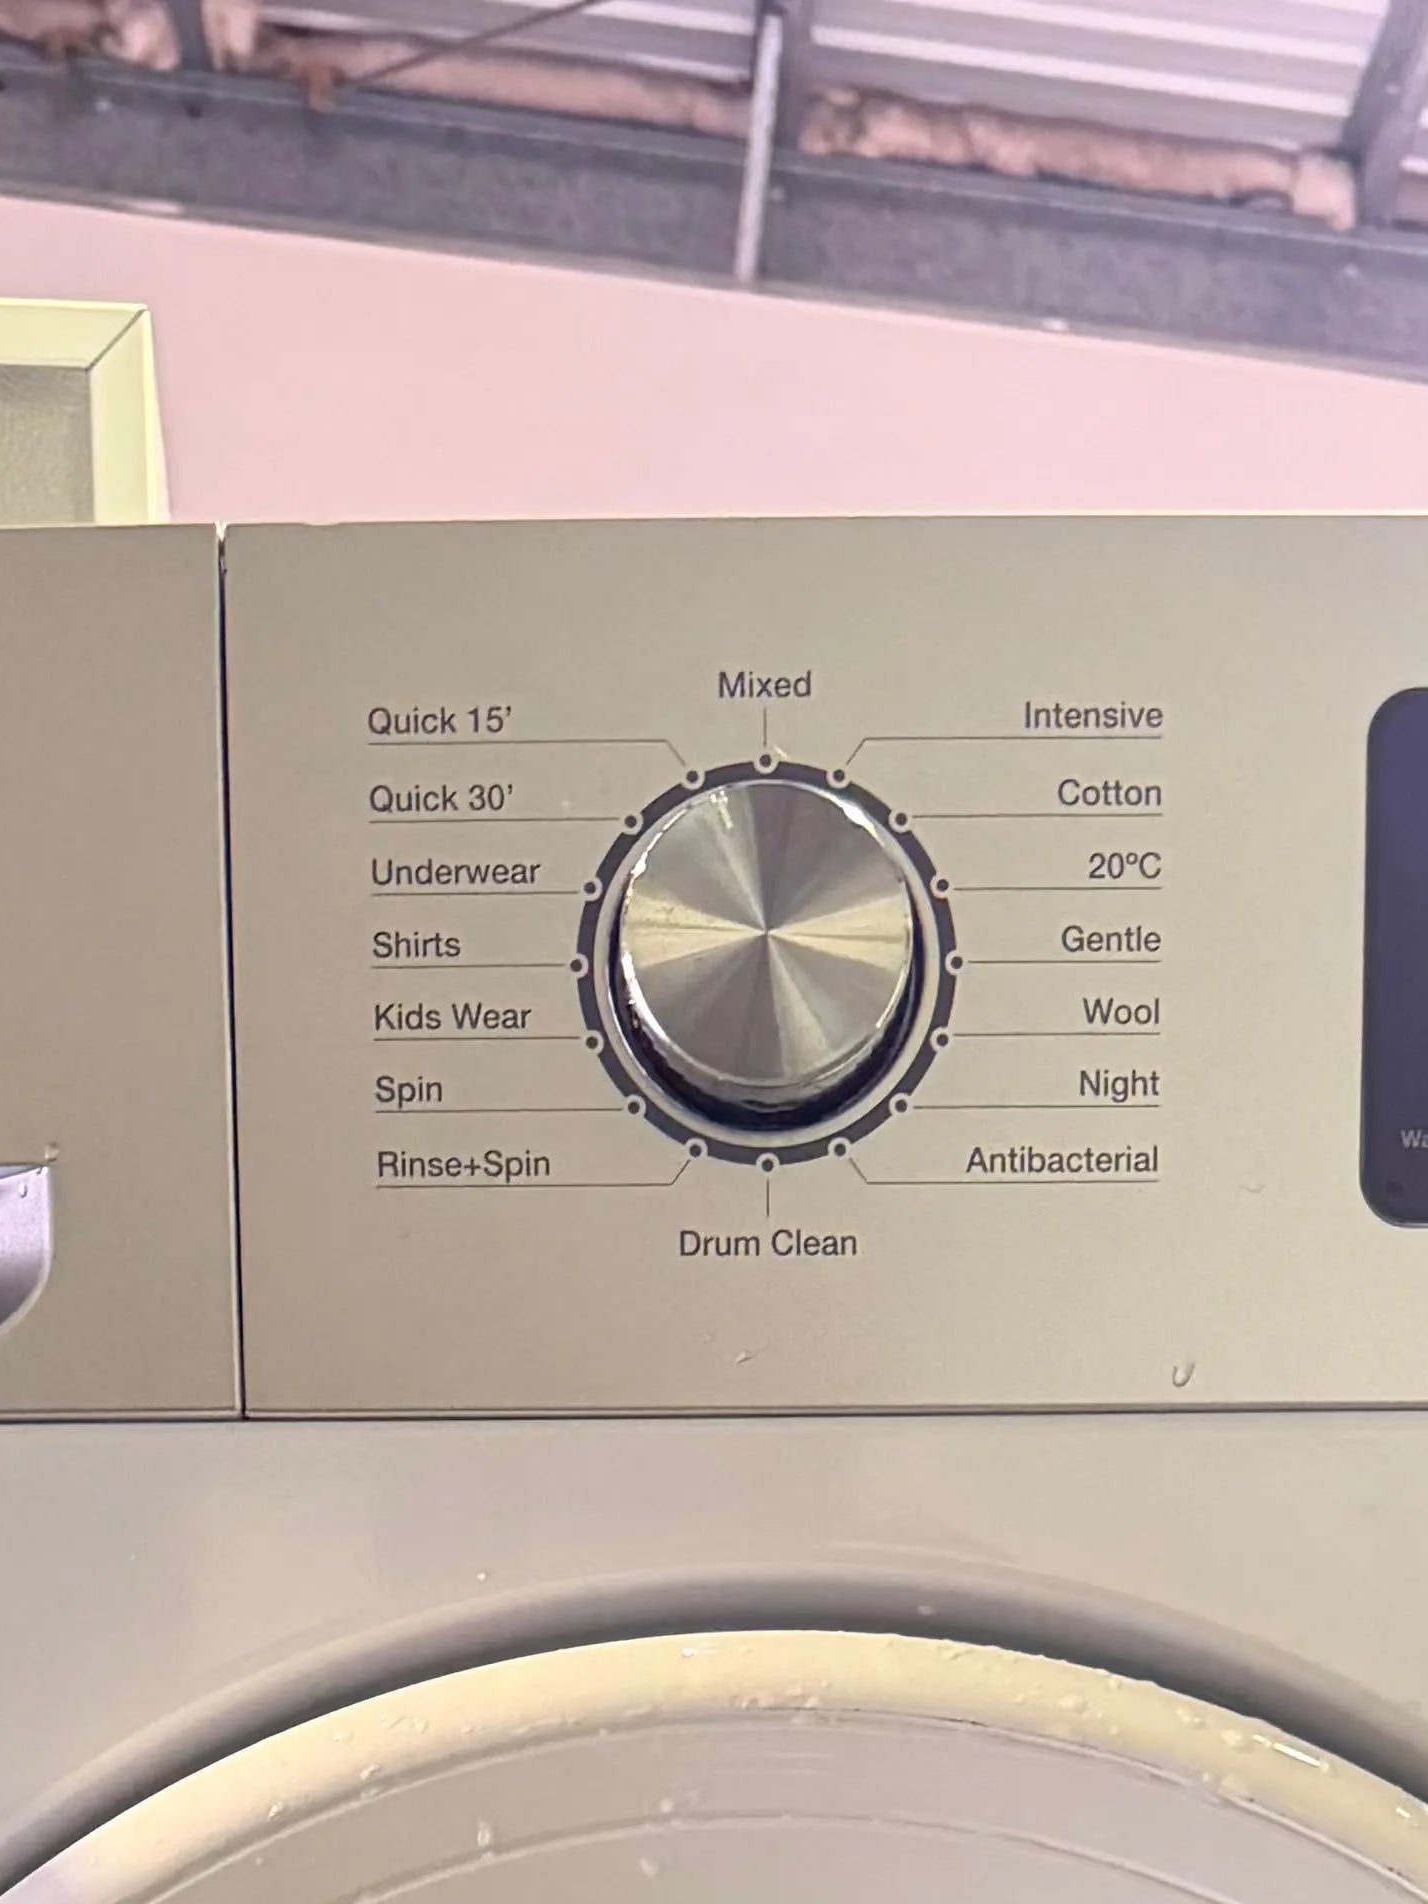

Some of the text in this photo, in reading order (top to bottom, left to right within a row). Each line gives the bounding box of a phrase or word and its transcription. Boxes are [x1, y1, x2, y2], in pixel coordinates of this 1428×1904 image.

[718, 671, 811, 699] Mixed
[368, 706, 513, 735] Quick 15'
[1024, 702, 1163, 729] Intensive
[369, 784, 513, 813] Quick 30'
[1057, 779, 1162, 806] Cotton
[371, 859, 540, 885] Underwear
[1088, 853, 1162, 880] 20°C
[372, 931, 461, 958] Shirts
[1060, 925, 1162, 953] Gentle
[375, 1004, 532, 1030] Kids Wear
[1083, 998, 1160, 1025] Wool
[375, 1075, 443, 1105] Spin
[1079, 1070, 1160, 1100] Night
[377, 1151, 551, 1181] Rinse+Spin
[966, 1146, 1159, 1174] Antibacterial
[679, 1230, 857, 1257] Drum Clean
